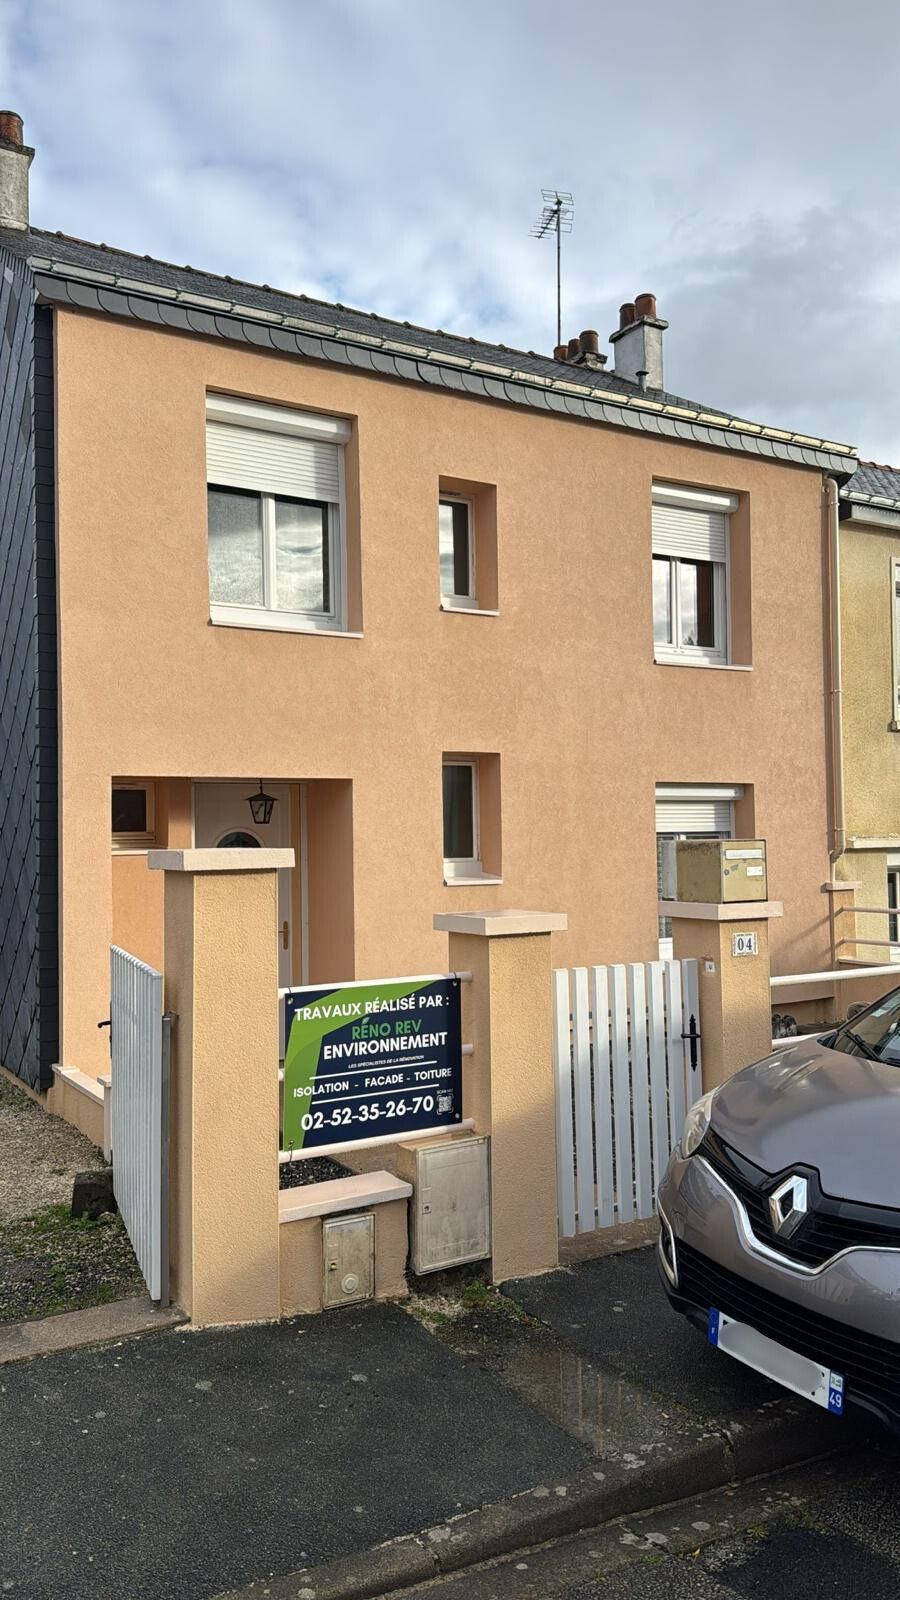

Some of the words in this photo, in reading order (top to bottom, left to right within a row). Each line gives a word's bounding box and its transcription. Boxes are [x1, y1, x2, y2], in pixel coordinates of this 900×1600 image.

[738, 938, 752, 951] 04
[294, 1003, 361, 1021] TRAVAUX
[365, 993, 415, 1014] RÉALISÉ
[419, 995, 442, 1008] PAR
[352, 1017, 391, 1040] RÉNO
[395, 1019, 422, 1034] REV
[323, 1032, 448, 1060] ENVIRONNEMENT
[293, 1081, 349, 1098] ISOLATION
[365, 1073, 404, 1088] FACADE
[414, 1068, 452, 1082] TOITURE
[301, 1095, 434, 1131] 02-52-35-26-70
[829, 1393, 842, 1408] 49
